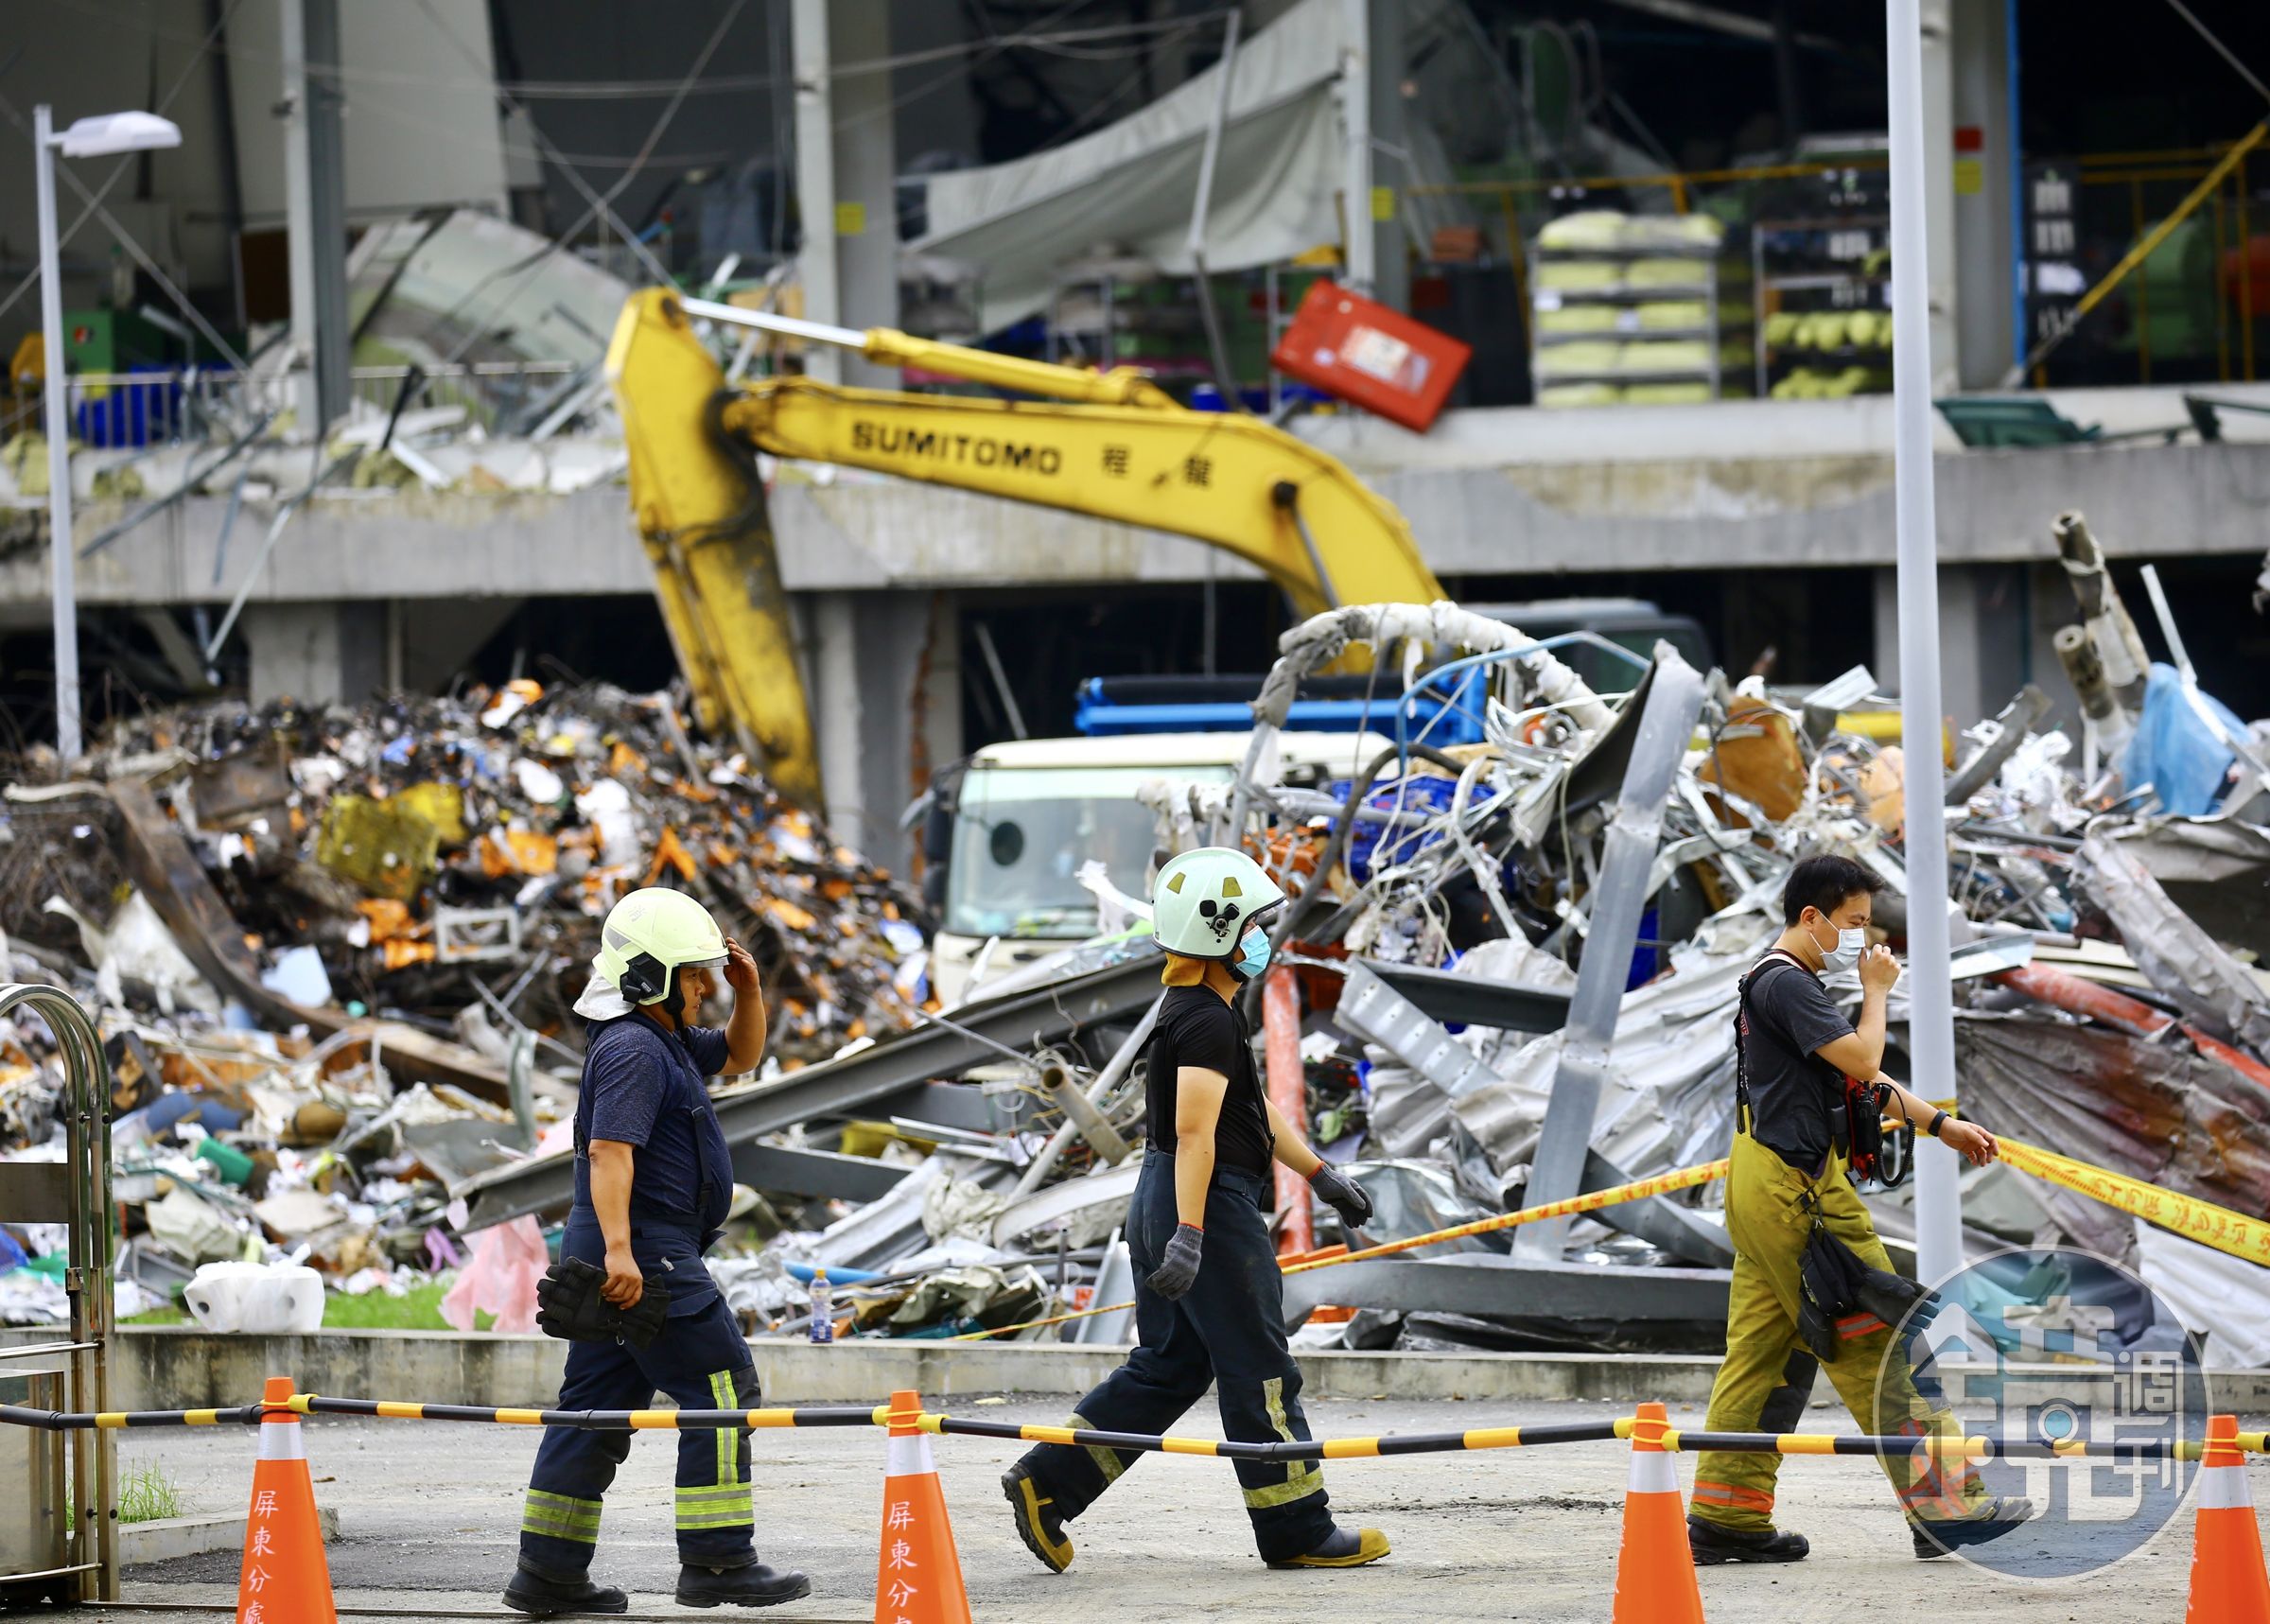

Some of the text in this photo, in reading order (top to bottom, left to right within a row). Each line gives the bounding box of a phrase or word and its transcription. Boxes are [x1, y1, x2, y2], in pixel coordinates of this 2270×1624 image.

[851, 421, 1062, 476] SUMITOMO
[887, 1501, 918, 1624] 屏東分
